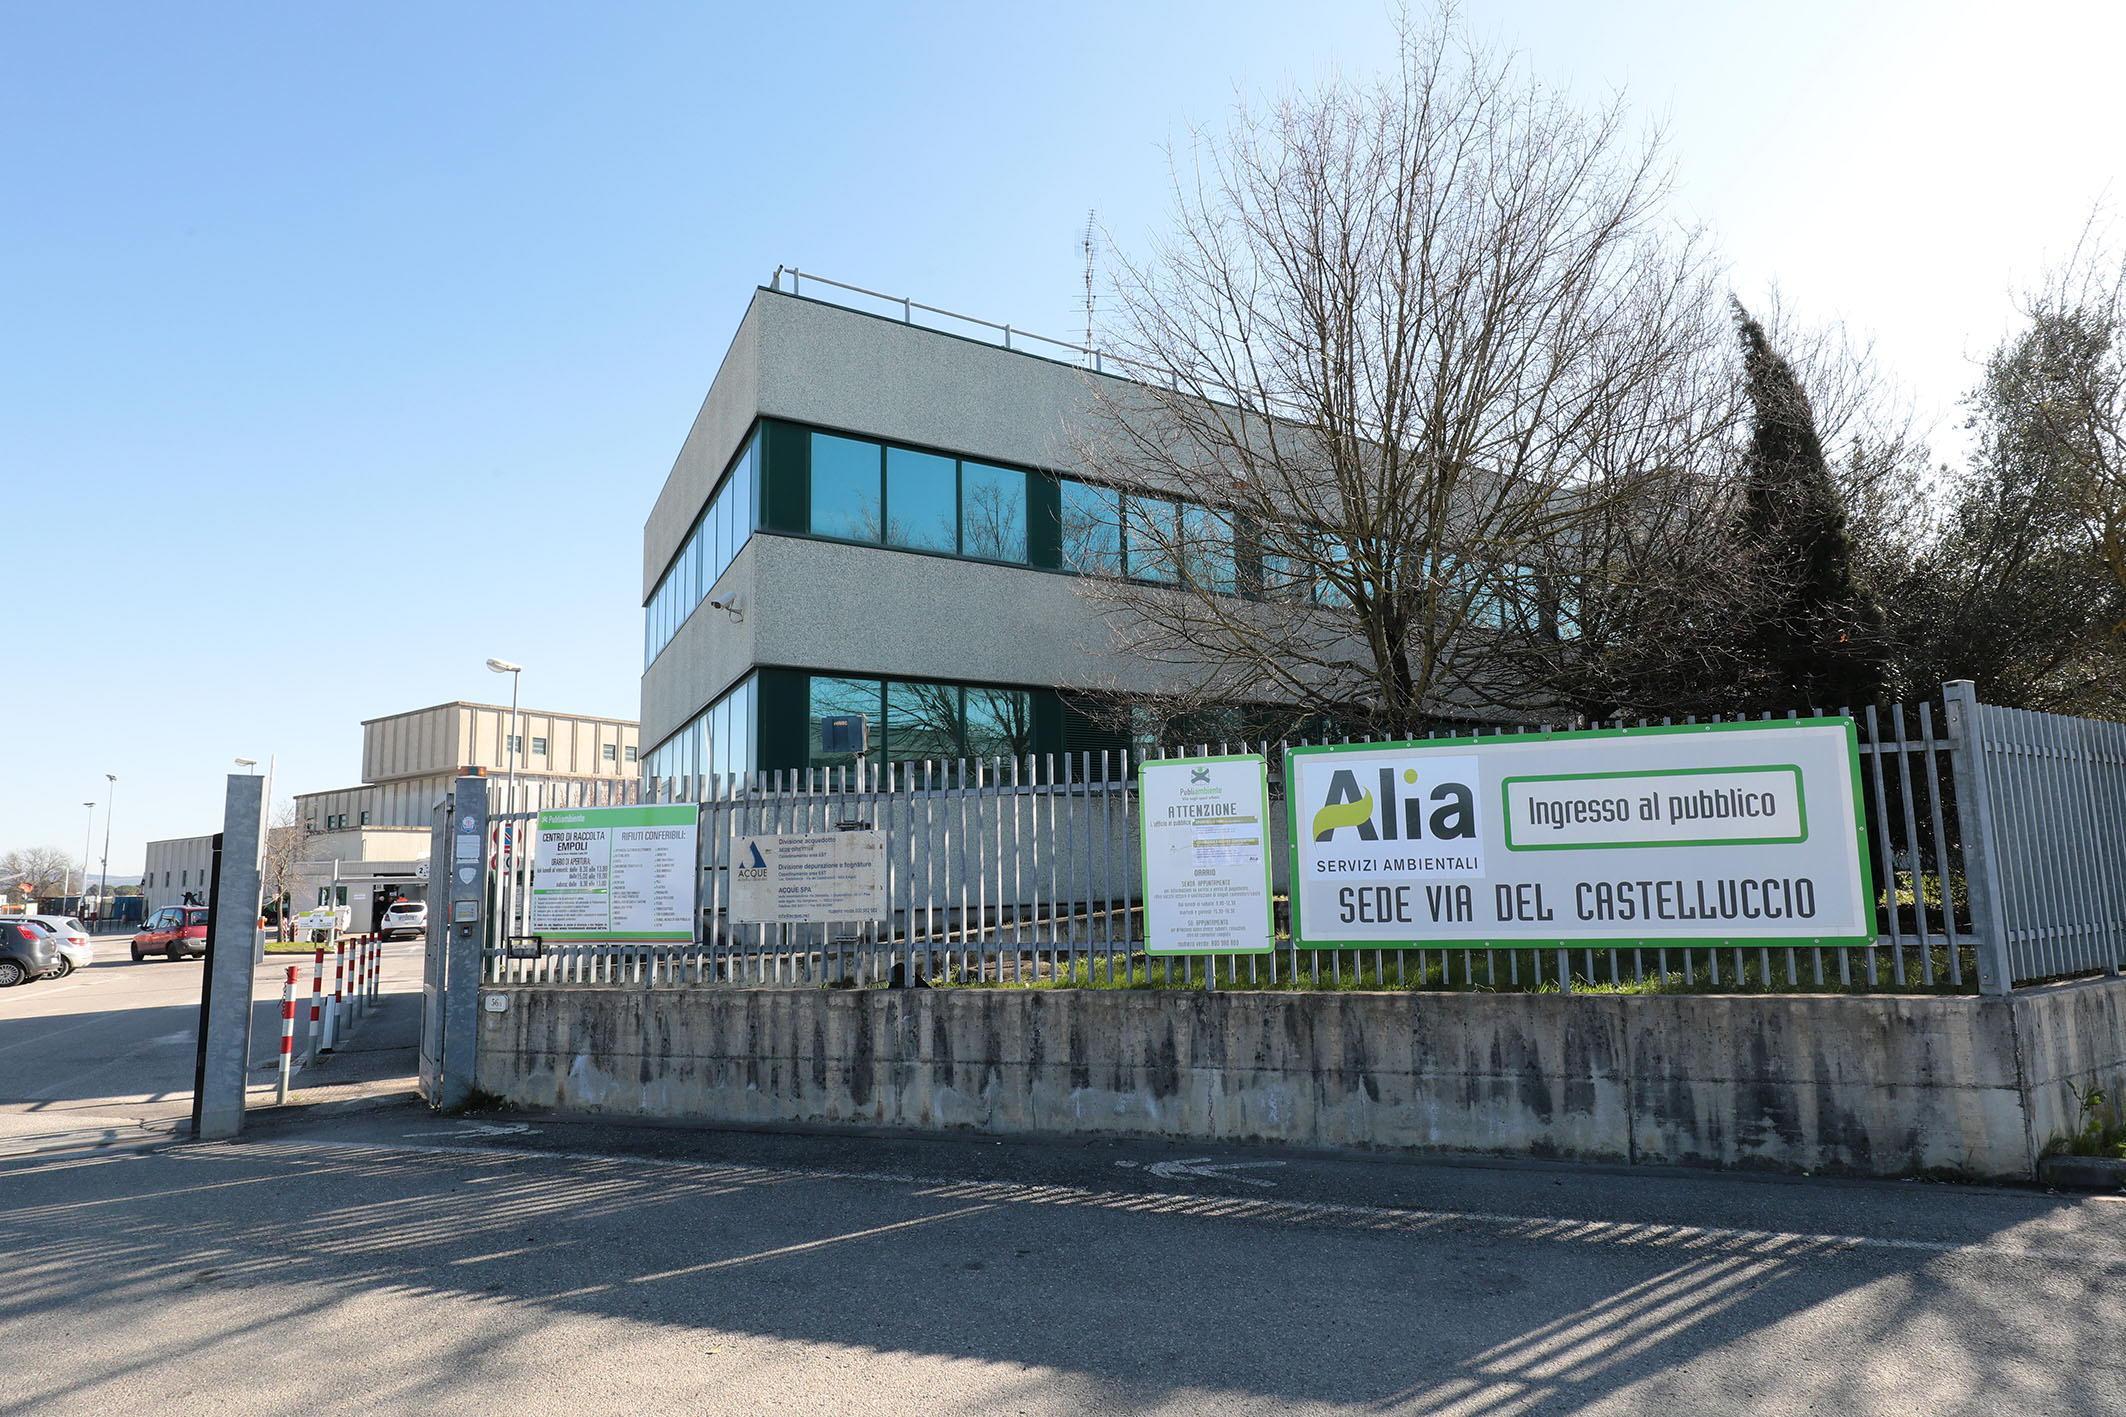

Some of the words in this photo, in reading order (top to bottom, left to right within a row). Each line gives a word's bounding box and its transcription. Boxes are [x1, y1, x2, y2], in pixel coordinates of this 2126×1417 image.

[1168, 802, 1238, 819] ATTENZIONE
[1313, 768, 1476, 843] Alia
[1528, 796, 1630, 830] Ingresso
[1639, 791, 1660, 821] al
[1668, 788, 1776, 826] pubblico
[542, 832, 565, 843] CENTRO
[565, 832, 572, 842] DI
[573, 831, 606, 842] RACCOLTA
[621, 831, 644, 841] RIFIUTI
[804, 837, 837, 846] acquedotto
[557, 841, 588, 852] EMPOLI
[804, 862, 839, 871] depurazione
[1316, 859, 1377, 873] SERVIZI
[1383, 857, 1478, 872] AMBIENTALI
[737, 868, 768, 879] ACQUE
[1193, 868, 1217, 877] ORARIO
[1339, 886, 1412, 924] SEDE
[1425, 884, 1473, 922] VIA
[1495, 883, 1554, 922] DEL
[1575, 878, 1816, 922] CASTELLUCCIO
